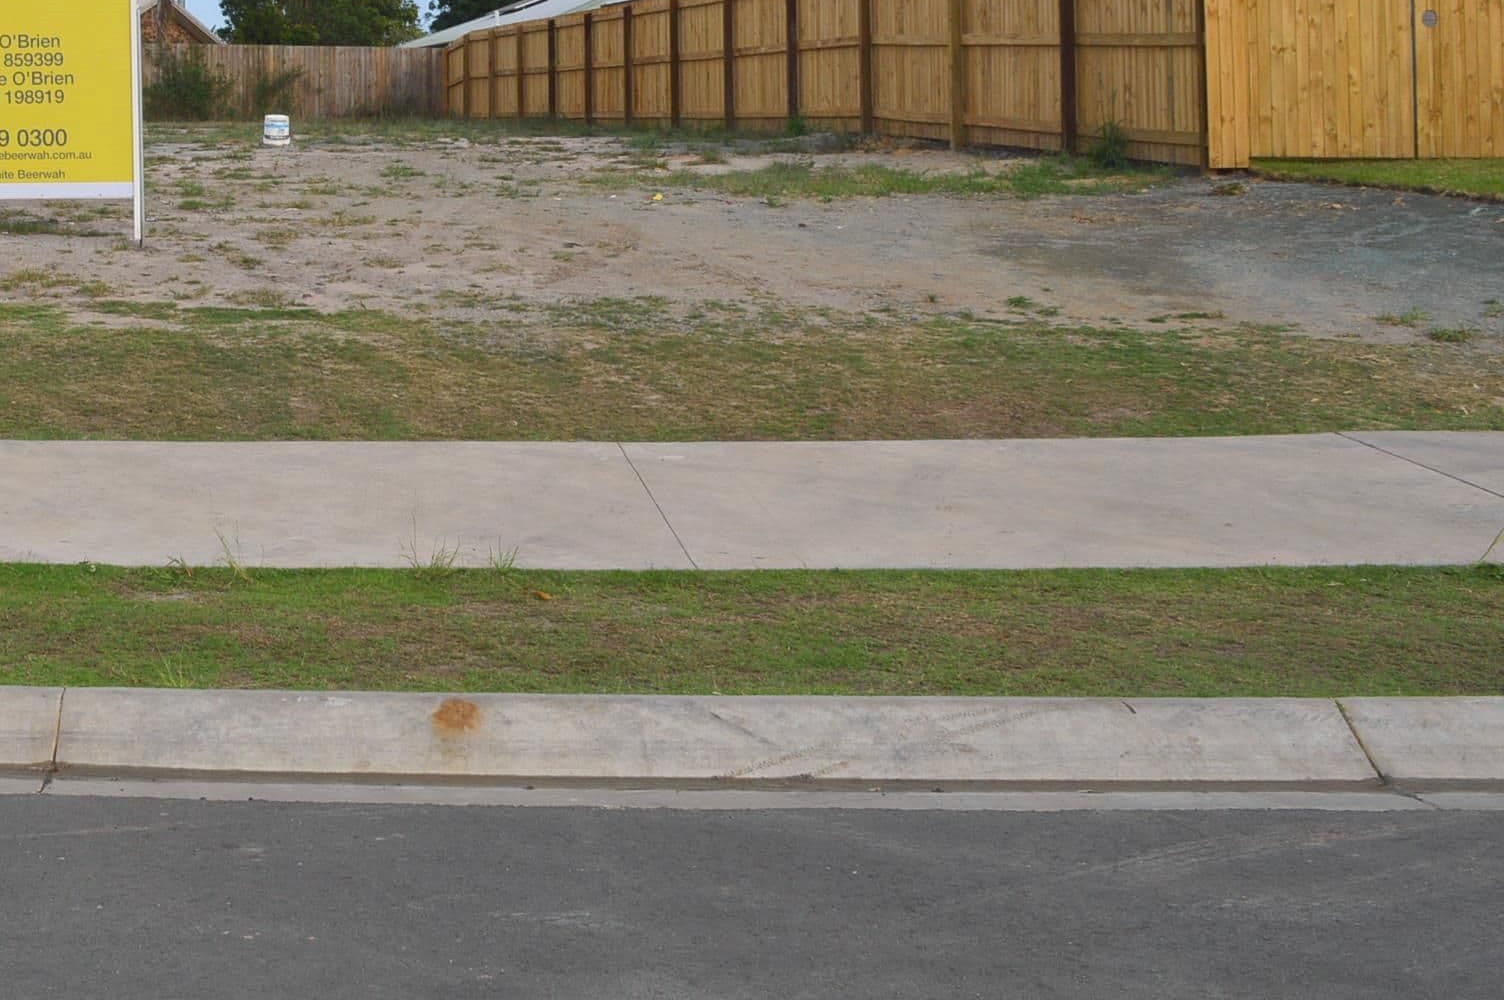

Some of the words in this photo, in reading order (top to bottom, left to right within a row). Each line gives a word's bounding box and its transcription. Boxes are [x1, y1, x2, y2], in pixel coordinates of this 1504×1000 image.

[3, 52, 64, 68] 859399
[12, 71, 75, 86] O'Brien
[5, 89, 65, 104] 198919
[17, 129, 68, 147] 0300
[17, 170, 66, 179] Beerwah
